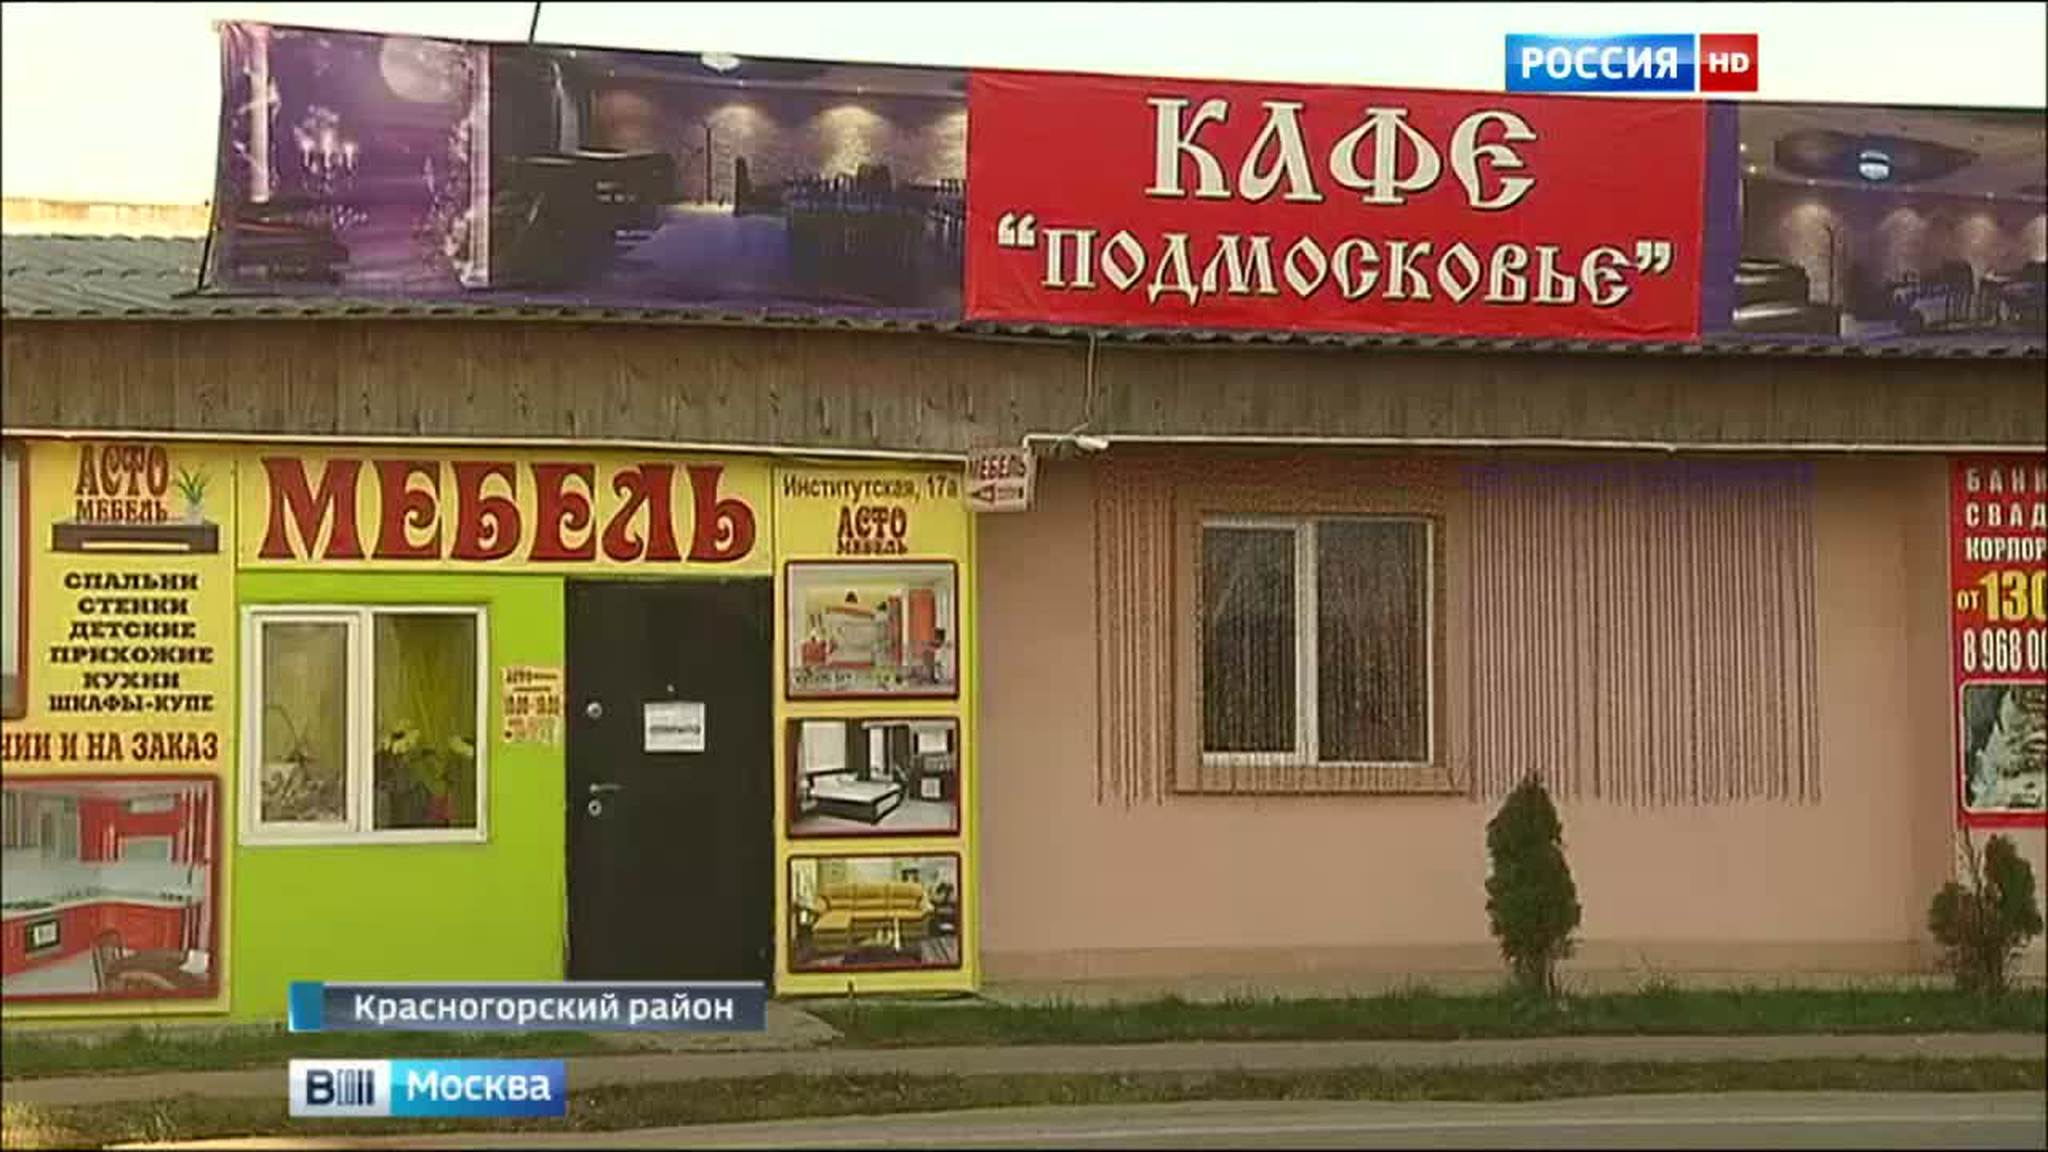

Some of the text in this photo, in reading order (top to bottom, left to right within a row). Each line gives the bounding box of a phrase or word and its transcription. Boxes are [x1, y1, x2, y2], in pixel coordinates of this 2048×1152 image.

[1146, 97, 1538, 211] КАФЕ
[75, 445, 169, 497] АСТО
[783, 473, 921, 504] Институтская,
[76, 498, 168, 522] МЕБЕЛЬ
[258, 458, 757, 563] МЕБЕЛЬ
[837, 506, 908, 538] АСТО
[1965, 501, 2047, 532] СВАД
[1965, 535, 2047, 562] КОРПОР
[63, 572, 199, 591] СПАЛЬНИ
[77, 597, 189, 616] СТЕНКИ
[68, 620, 197, 642] ДЕТСКИЕ
[49, 646, 214, 665] ПРИХОЖИЕ
[1963, 627, 1977, 673] 8
[1980, 627, 2022, 673] 968
[83, 671, 180, 690] КУХНИ
[49, 694, 215, 712] ШКАФЫ-КУПЕ
[60, 732, 79, 762] И
[86, 732, 125, 762] НА
[131, 731, 219, 762] ЗАКАЗ
